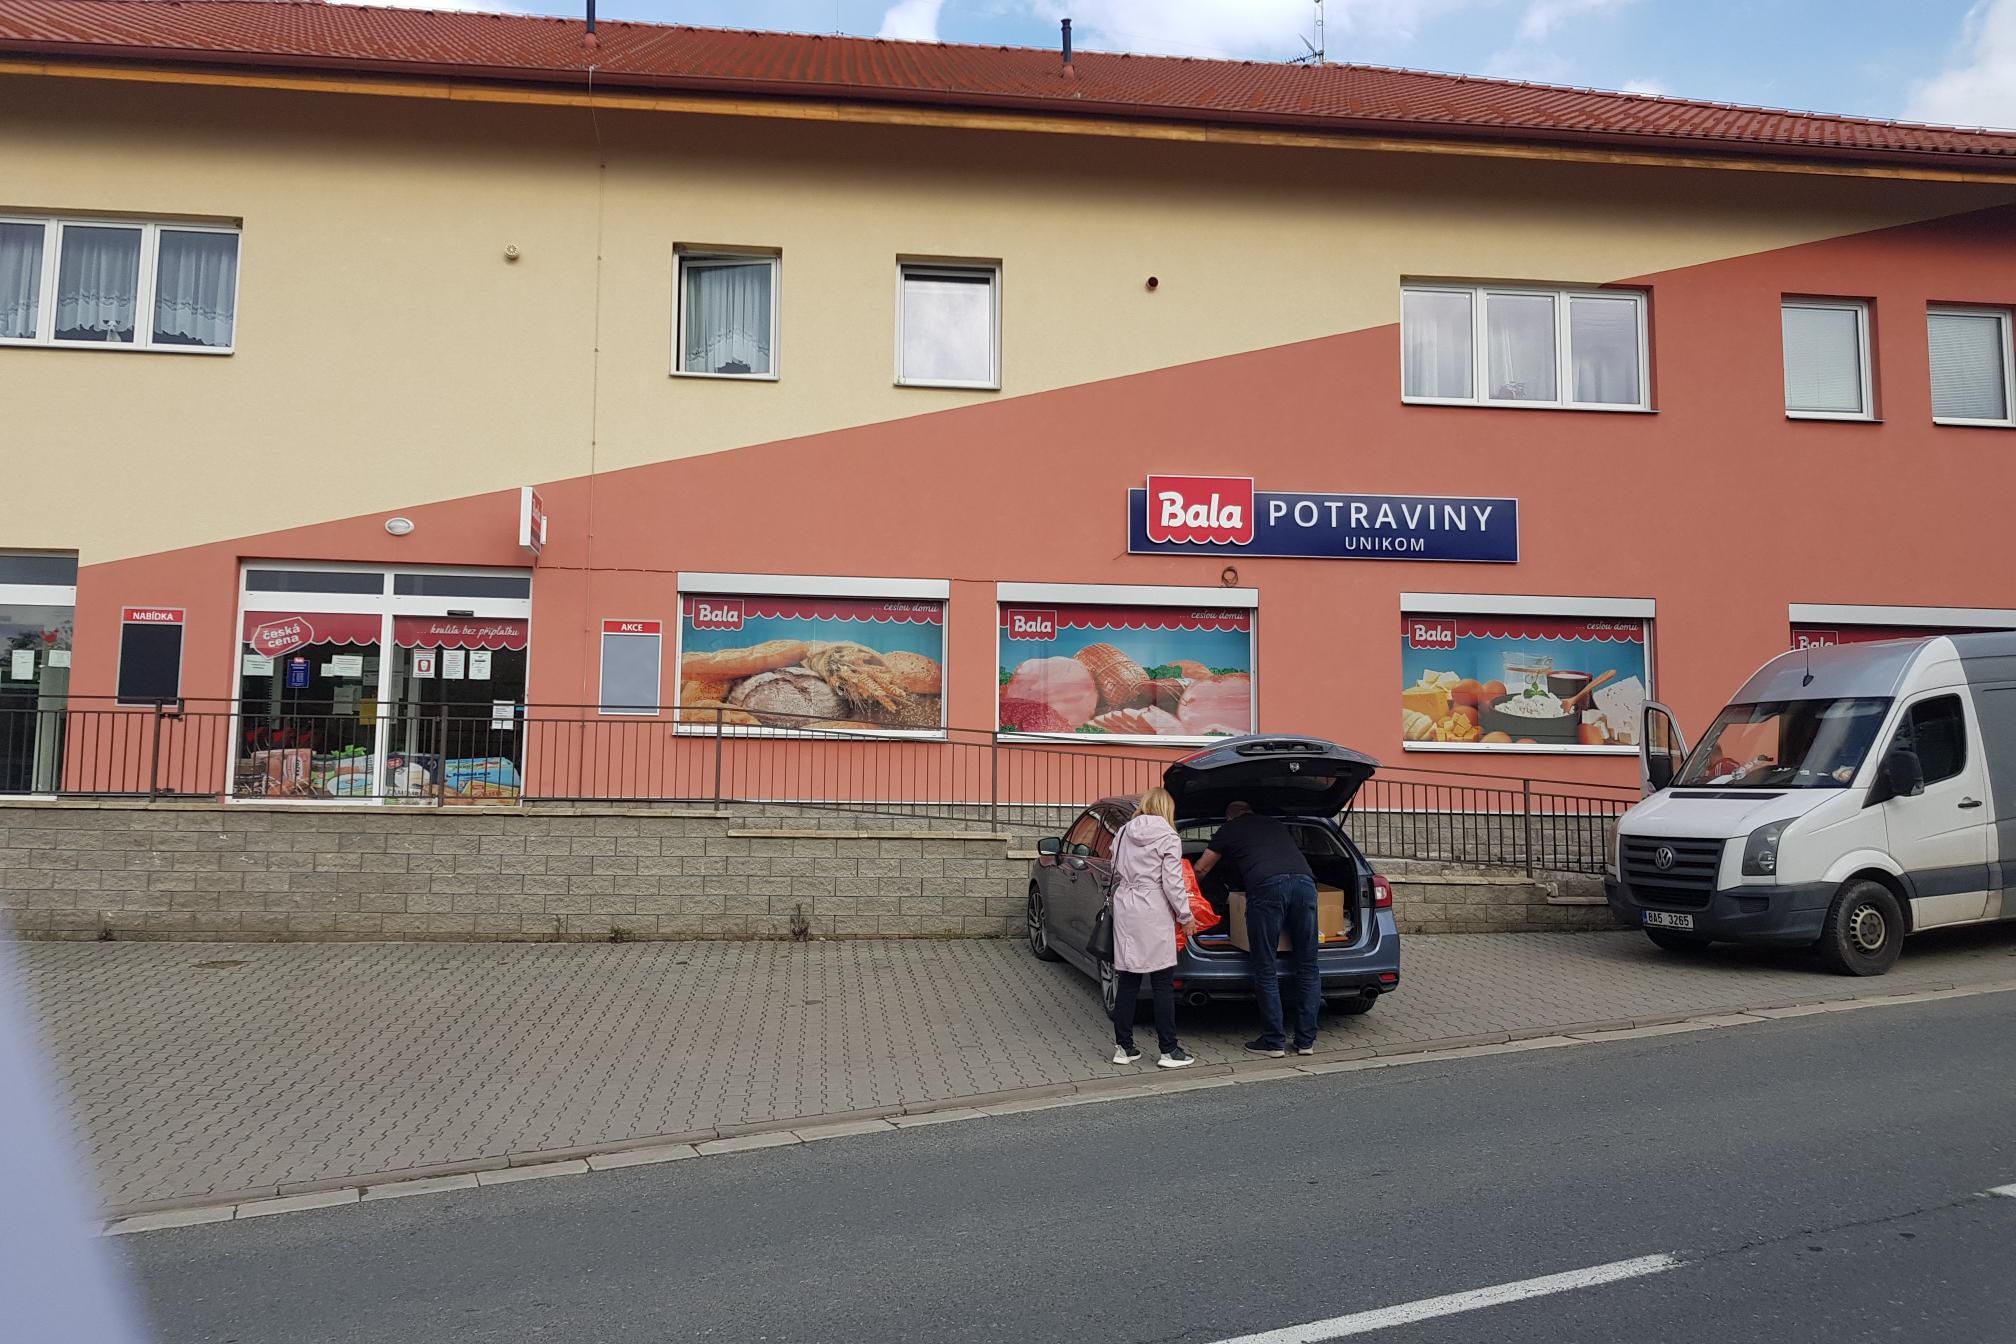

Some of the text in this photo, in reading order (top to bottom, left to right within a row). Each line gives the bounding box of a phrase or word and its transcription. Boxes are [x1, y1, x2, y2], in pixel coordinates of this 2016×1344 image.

[1158, 491, 1243, 529] Bala
[1268, 500, 1493, 532] POTRAVINY
[1345, 536, 1425, 552] UNIKOM
[132, 611, 174, 621] NABÍDKA
[698, 604, 739, 622] Bala
[263, 623, 300, 640] česká
[462, 625, 476, 635] bez
[620, 623, 643, 632] AKCE
[1013, 615, 1052, 633] Bala
[1414, 624, 1452, 642] Bala
[268, 635, 299, 648] cena
[1668, 914, 1689, 927] 3265
